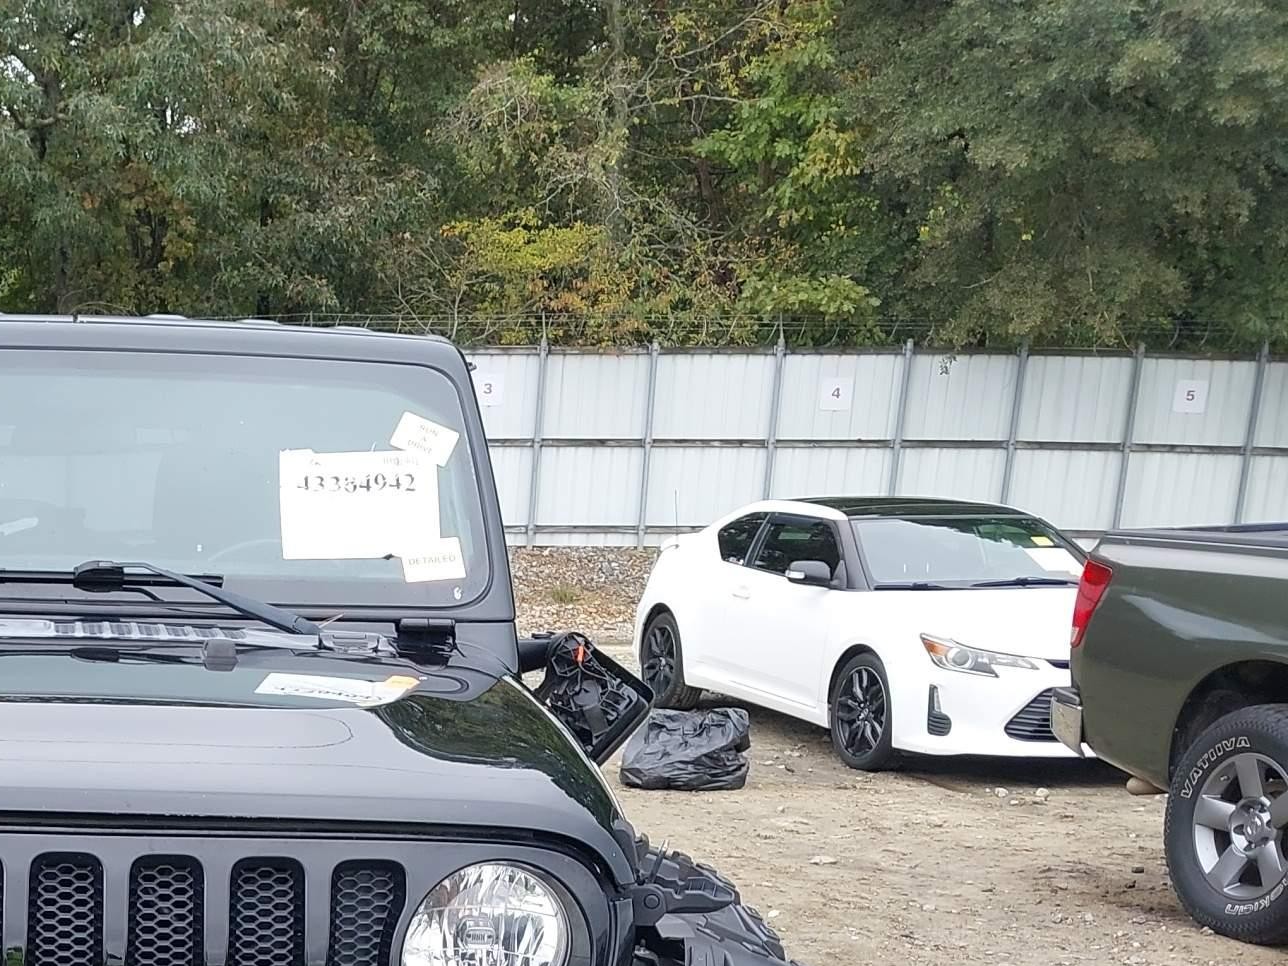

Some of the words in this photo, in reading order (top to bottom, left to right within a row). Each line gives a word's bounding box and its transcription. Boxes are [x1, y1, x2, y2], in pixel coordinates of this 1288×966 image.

[483, 383, 492, 394] 3
[831, 387, 841, 399] 4
[1186, 390, 1196, 402] 5
[296, 472, 416, 493] 43384942
[407, 553, 457, 567] DETAILED
